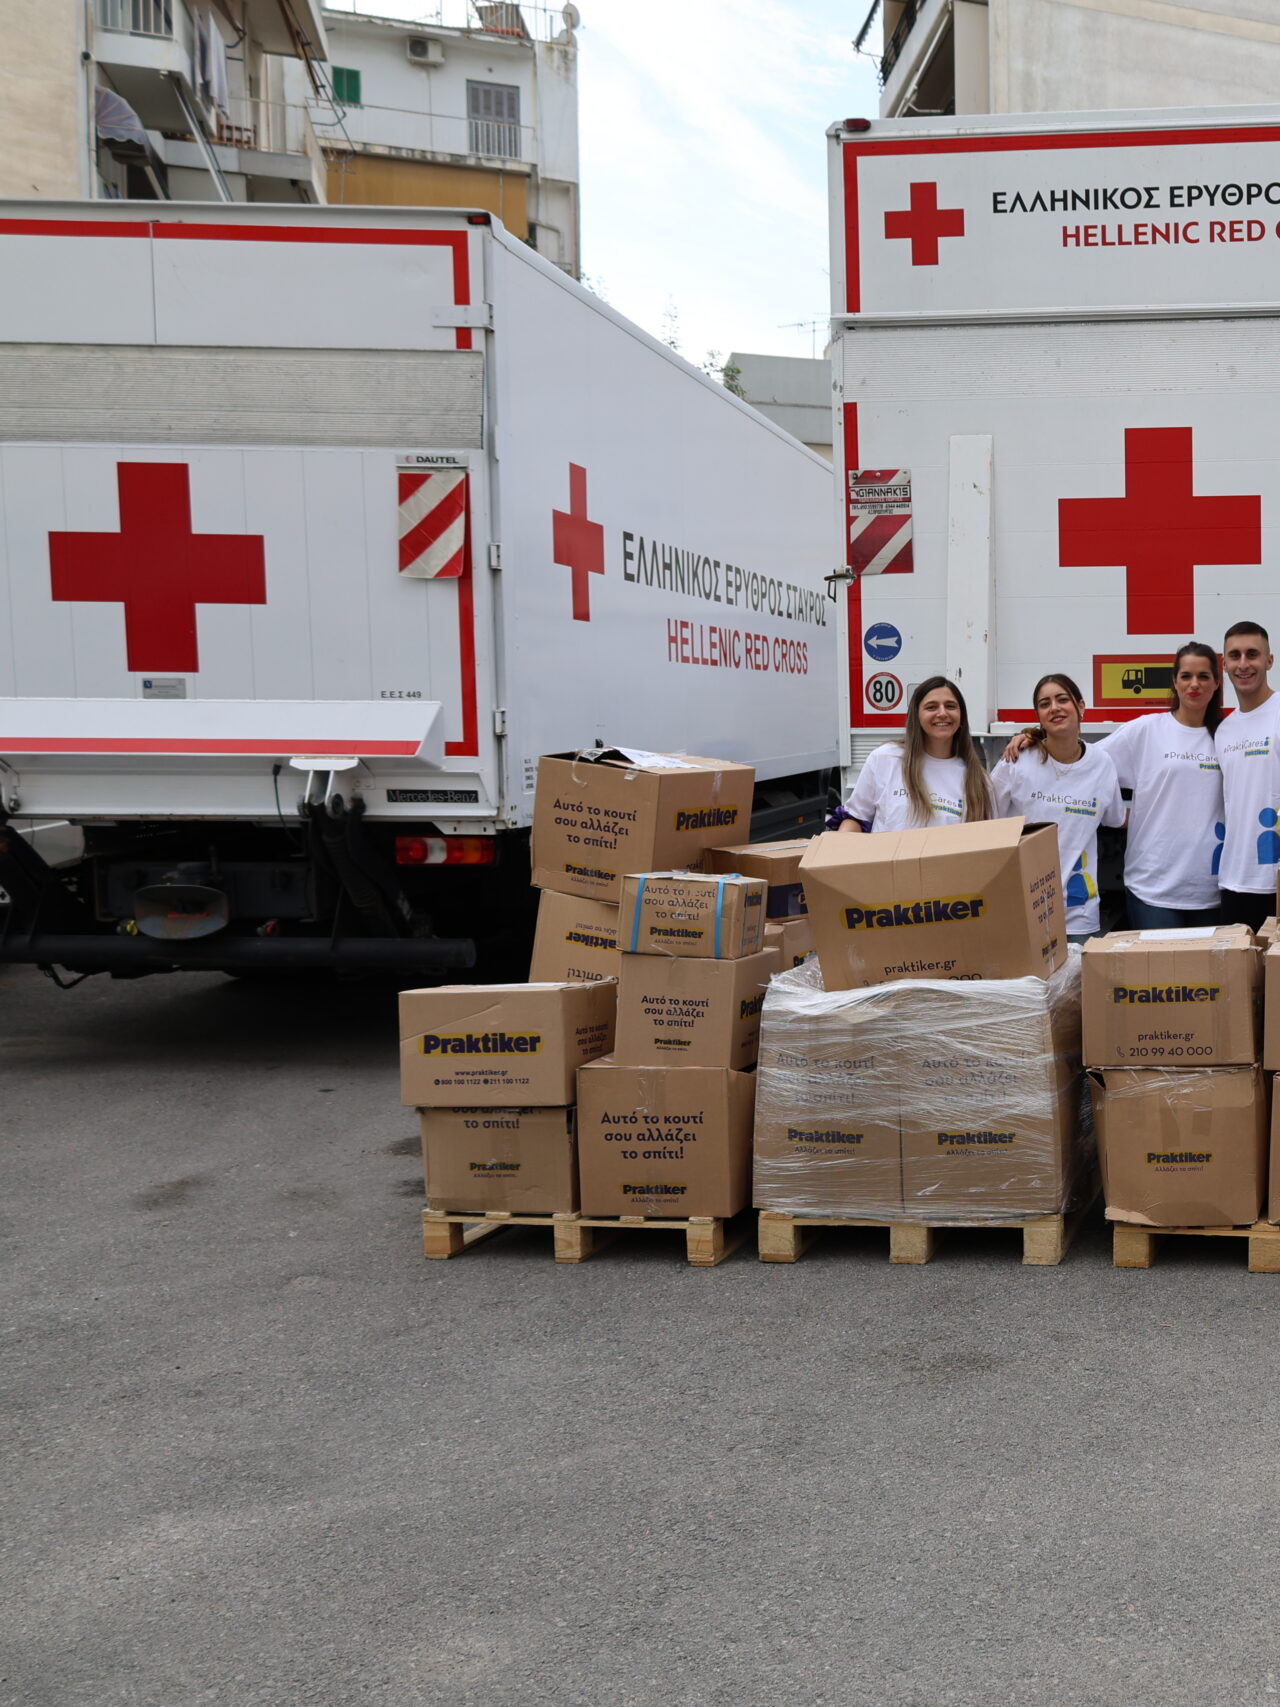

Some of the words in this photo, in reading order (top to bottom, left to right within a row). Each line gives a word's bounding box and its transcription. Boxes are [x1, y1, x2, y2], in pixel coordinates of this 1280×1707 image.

[993, 187, 1160, 214] ΕΛΛΗΝΙΚΟΣ
[1062, 221, 1200, 247] HELLENIC
[1209, 219, 1266, 243] RED
[416, 456, 459, 464] DAUTEL
[859, 487, 909, 498] GIANNAKIS
[622, 530, 722, 603] ΕΛΛΗΝΙΚΟΣ
[725, 564, 784, 617] ΕΡΥΘΡΟΣ
[786, 583, 827, 627] ΣΤΑΥΡΟΣ
[667, 618, 741, 669] HELLENIC
[745, 632, 770, 671] RED
[773, 637, 808, 675] CROSS
[406, 691, 422, 699] 449
[872, 680, 896, 703] 80
[1164, 751, 1220, 762] #PraktiCare
[388, 790, 477, 803] Mercedes-Benz
[553, 798, 583, 813] Αυτό
[587, 806, 601, 815] το
[604, 809, 637, 822] κουτί
[676, 808, 738, 831] Praktiker
[554, 817, 577, 827] σου
[580, 818, 629, 836] αλλάζει
[566, 833, 580, 844] το
[583, 835, 617, 850] σπίτι!
[565, 863, 616, 881] Praktiker
[643, 885, 670, 896] Αυτό
[673, 889, 685, 897] το
[644, 898, 664, 907] σου
[667, 897, 709, 910] αλλάζει
[655, 911, 667, 919] το
[845, 898, 984, 930] Praktiker
[649, 926, 704, 939] Praktiker
[565, 931, 617, 950] aktiker
[884, 958, 957, 976] praktiker.gr
[1113, 985, 1220, 1004] Praktiker
[641, 995, 666, 1005] Αυτό
[668, 998, 680, 1006] το
[682, 997, 710, 1008] κουτί
[644, 1007, 663, 1015] σου
[666, 1005, 705, 1019] αλλάζει
[653, 1018, 665, 1026] το
[667, 1018, 695, 1028] σπίτι!
[654, 1037, 692, 1047] Praktiker
[1137, 1031, 1195, 1042] praktiker.gr
[423, 1033, 541, 1054] Praktiker
[1129, 1047, 1148, 1057] 210
[1151, 1047, 1165, 1056] 99
[1168, 1047, 1184, 1056] 40
[1187, 1046, 1213, 1056] 000
[454, 1069, 508, 1077] www.praktiker.gr
[464, 1120, 479, 1129] το
[482, 1118, 520, 1129] σπίτι!
[601, 1112, 638, 1124] Αυτό
[642, 1115, 659, 1124] το
[664, 1112, 704, 1124] κουτί
[604, 1132, 632, 1142] σου
[636, 1128, 697, 1144] αλλάζει
[787, 1128, 864, 1144] Praktiker
[937, 1131, 1016, 1146] Praktiker
[621, 1151, 638, 1159] το
[642, 1147, 684, 1159] σπίτι!
[1147, 1152, 1212, 1165] Praktiker
[622, 1184, 687, 1195] Praktiker
